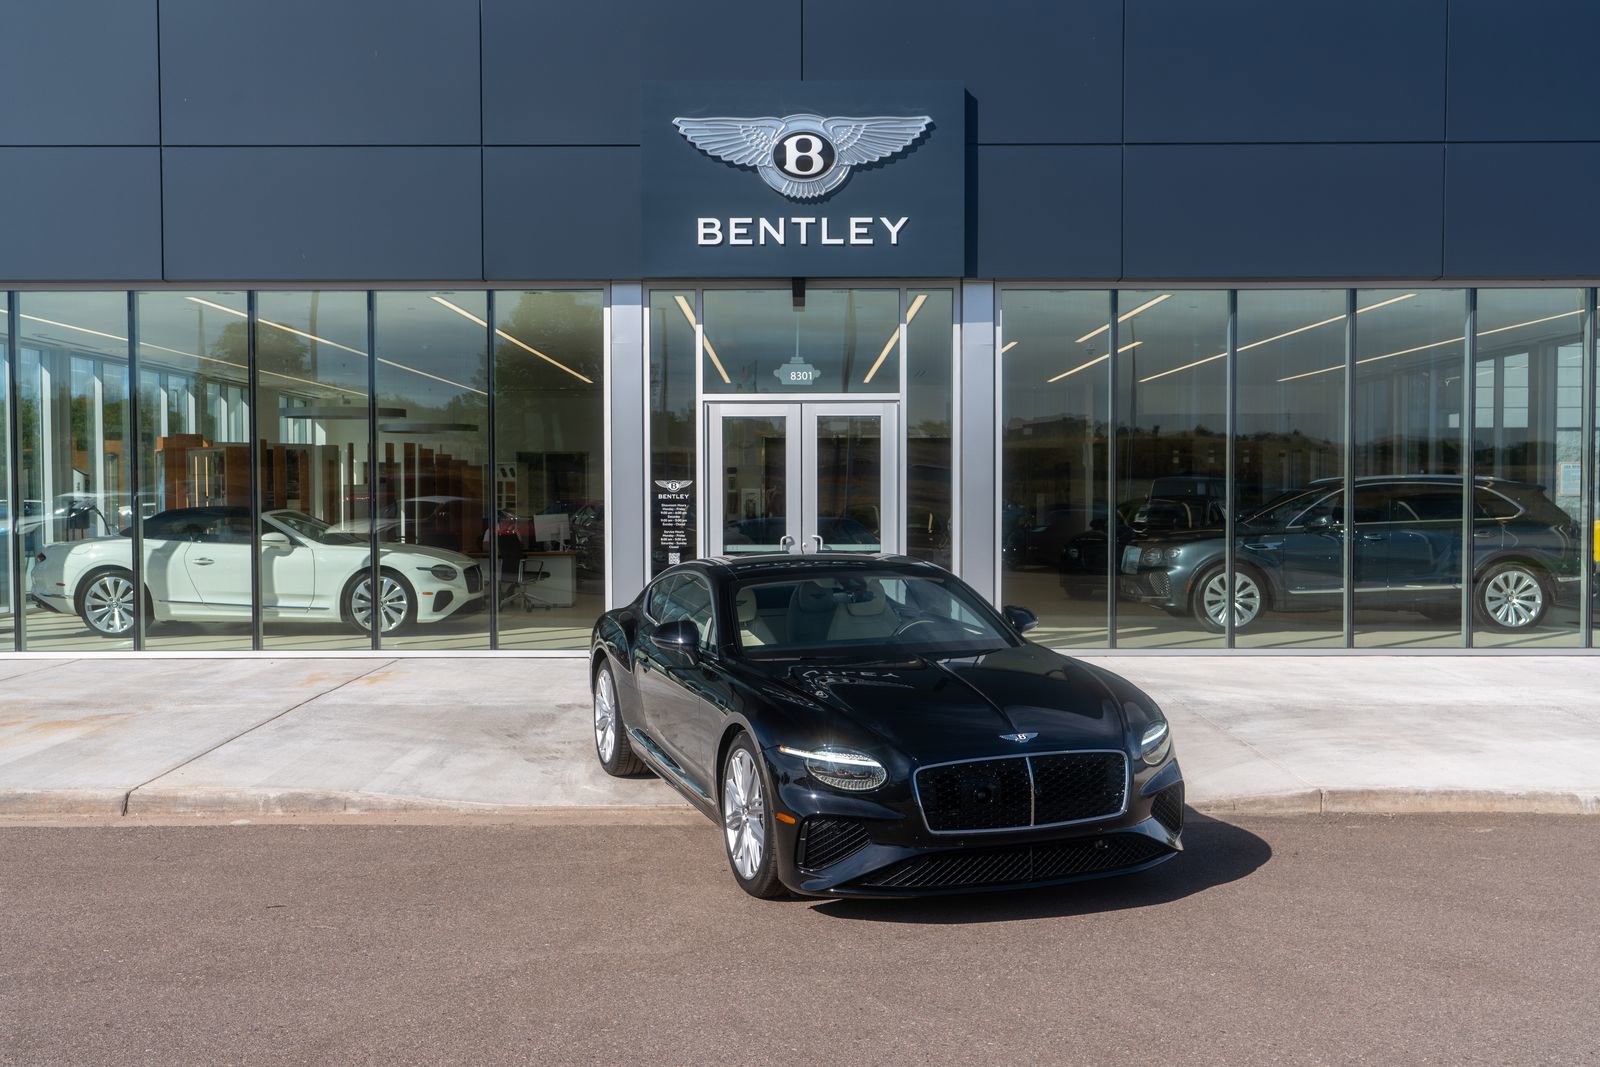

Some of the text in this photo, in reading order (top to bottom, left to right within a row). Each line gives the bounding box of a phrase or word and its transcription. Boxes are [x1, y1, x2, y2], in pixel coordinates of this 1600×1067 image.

[783, 134, 824, 176] B
[697, 216, 909, 245] BENTLEY
[790, 371, 812, 381] 8301
